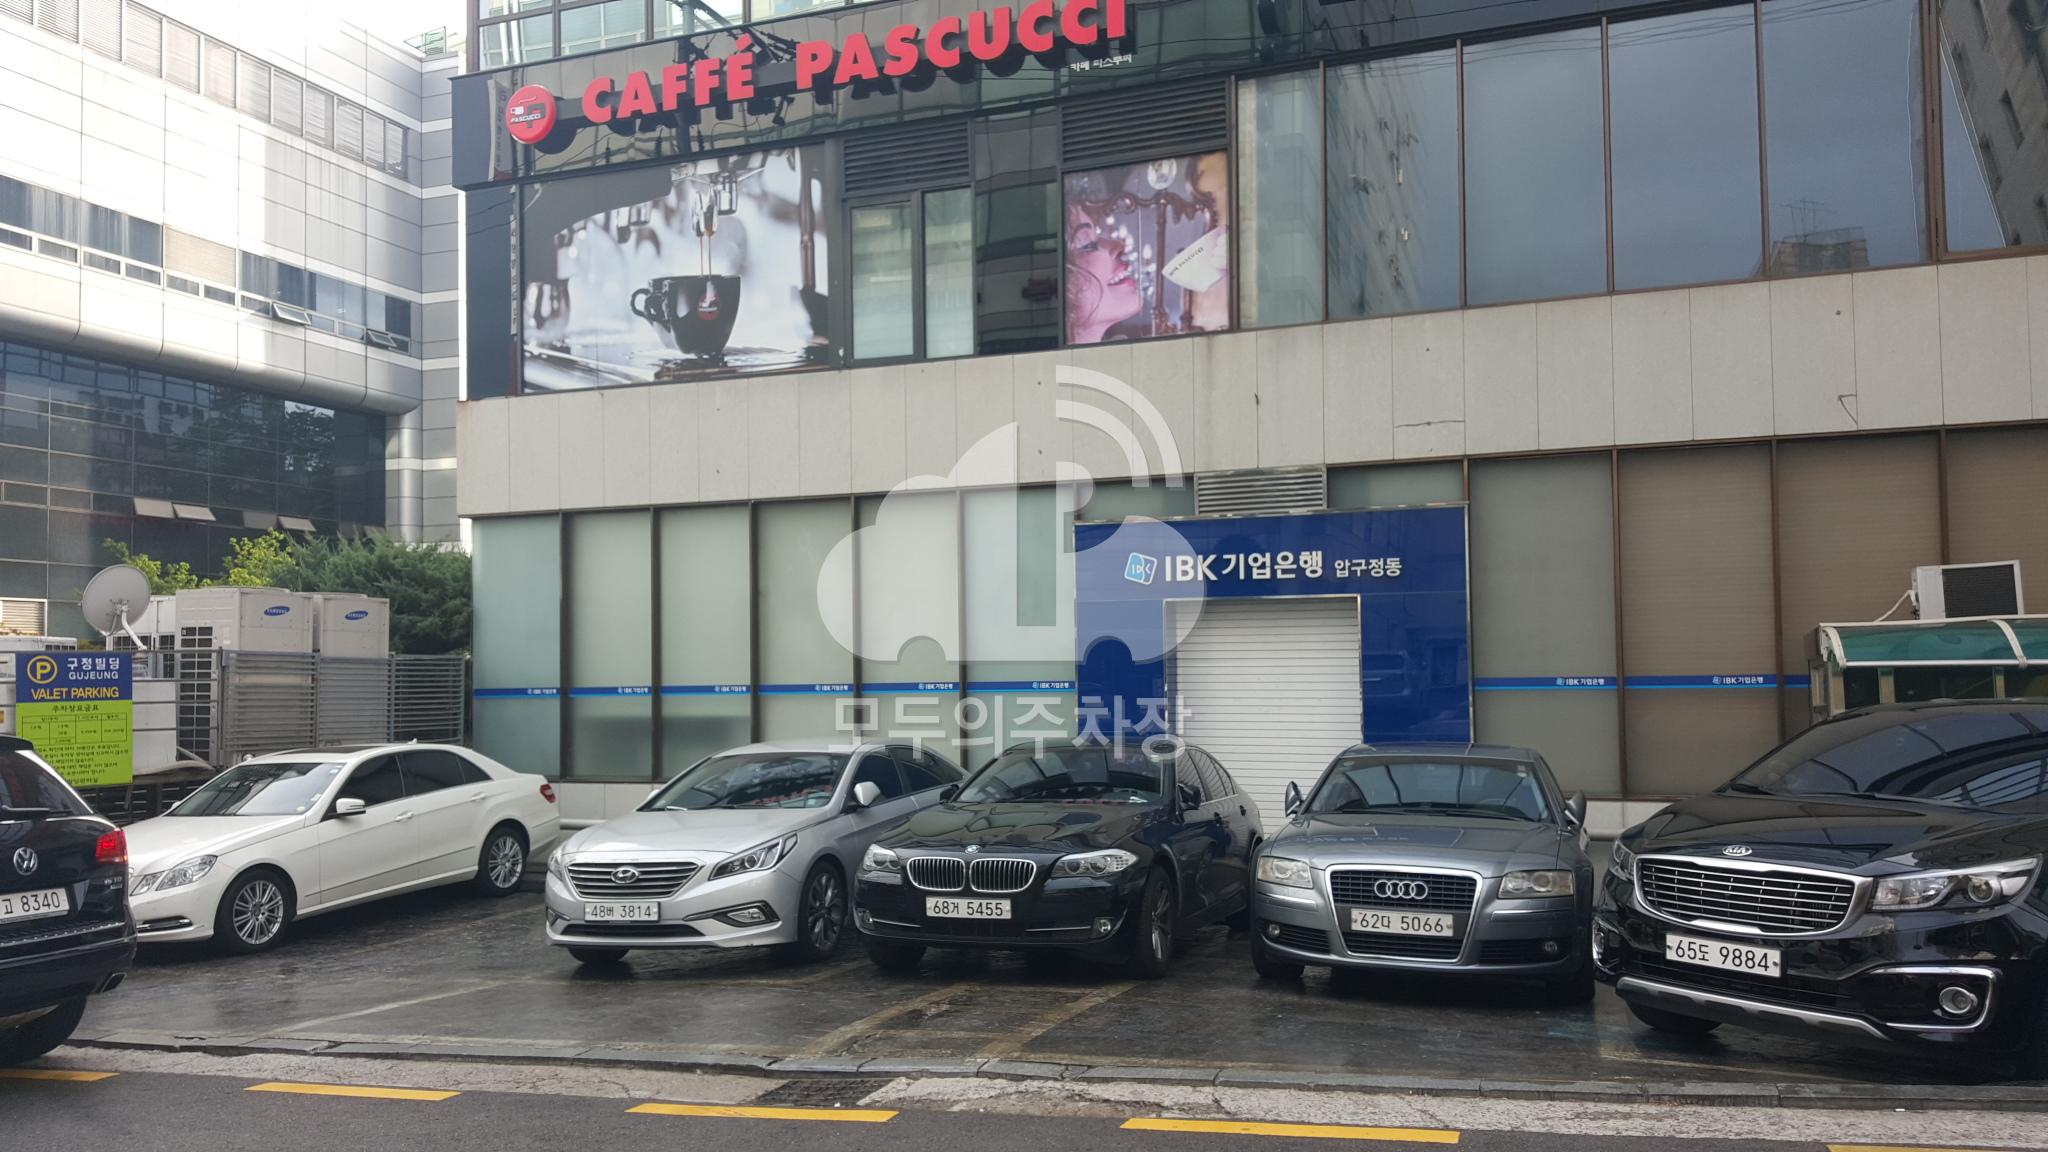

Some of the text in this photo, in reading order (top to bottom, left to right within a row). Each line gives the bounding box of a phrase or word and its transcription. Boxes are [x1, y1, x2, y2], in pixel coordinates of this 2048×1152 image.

[795, 0, 1127, 91] PASCUCCI
[1070, 60, 1090, 73] 카페
[1334, 557, 1402, 578] 압구정동
[69, 671, 119, 680] GUJEUNG
[31, 687, 119, 700] VALET PARKING
[20, 891, 61, 913] 8340
[933, 900, 1003, 916] 68거 5455
[620, 905, 652, 919] 3814
[1400, 915, 1444, 933] 5066
[1675, 939, 1770, 972] 65도 9884
